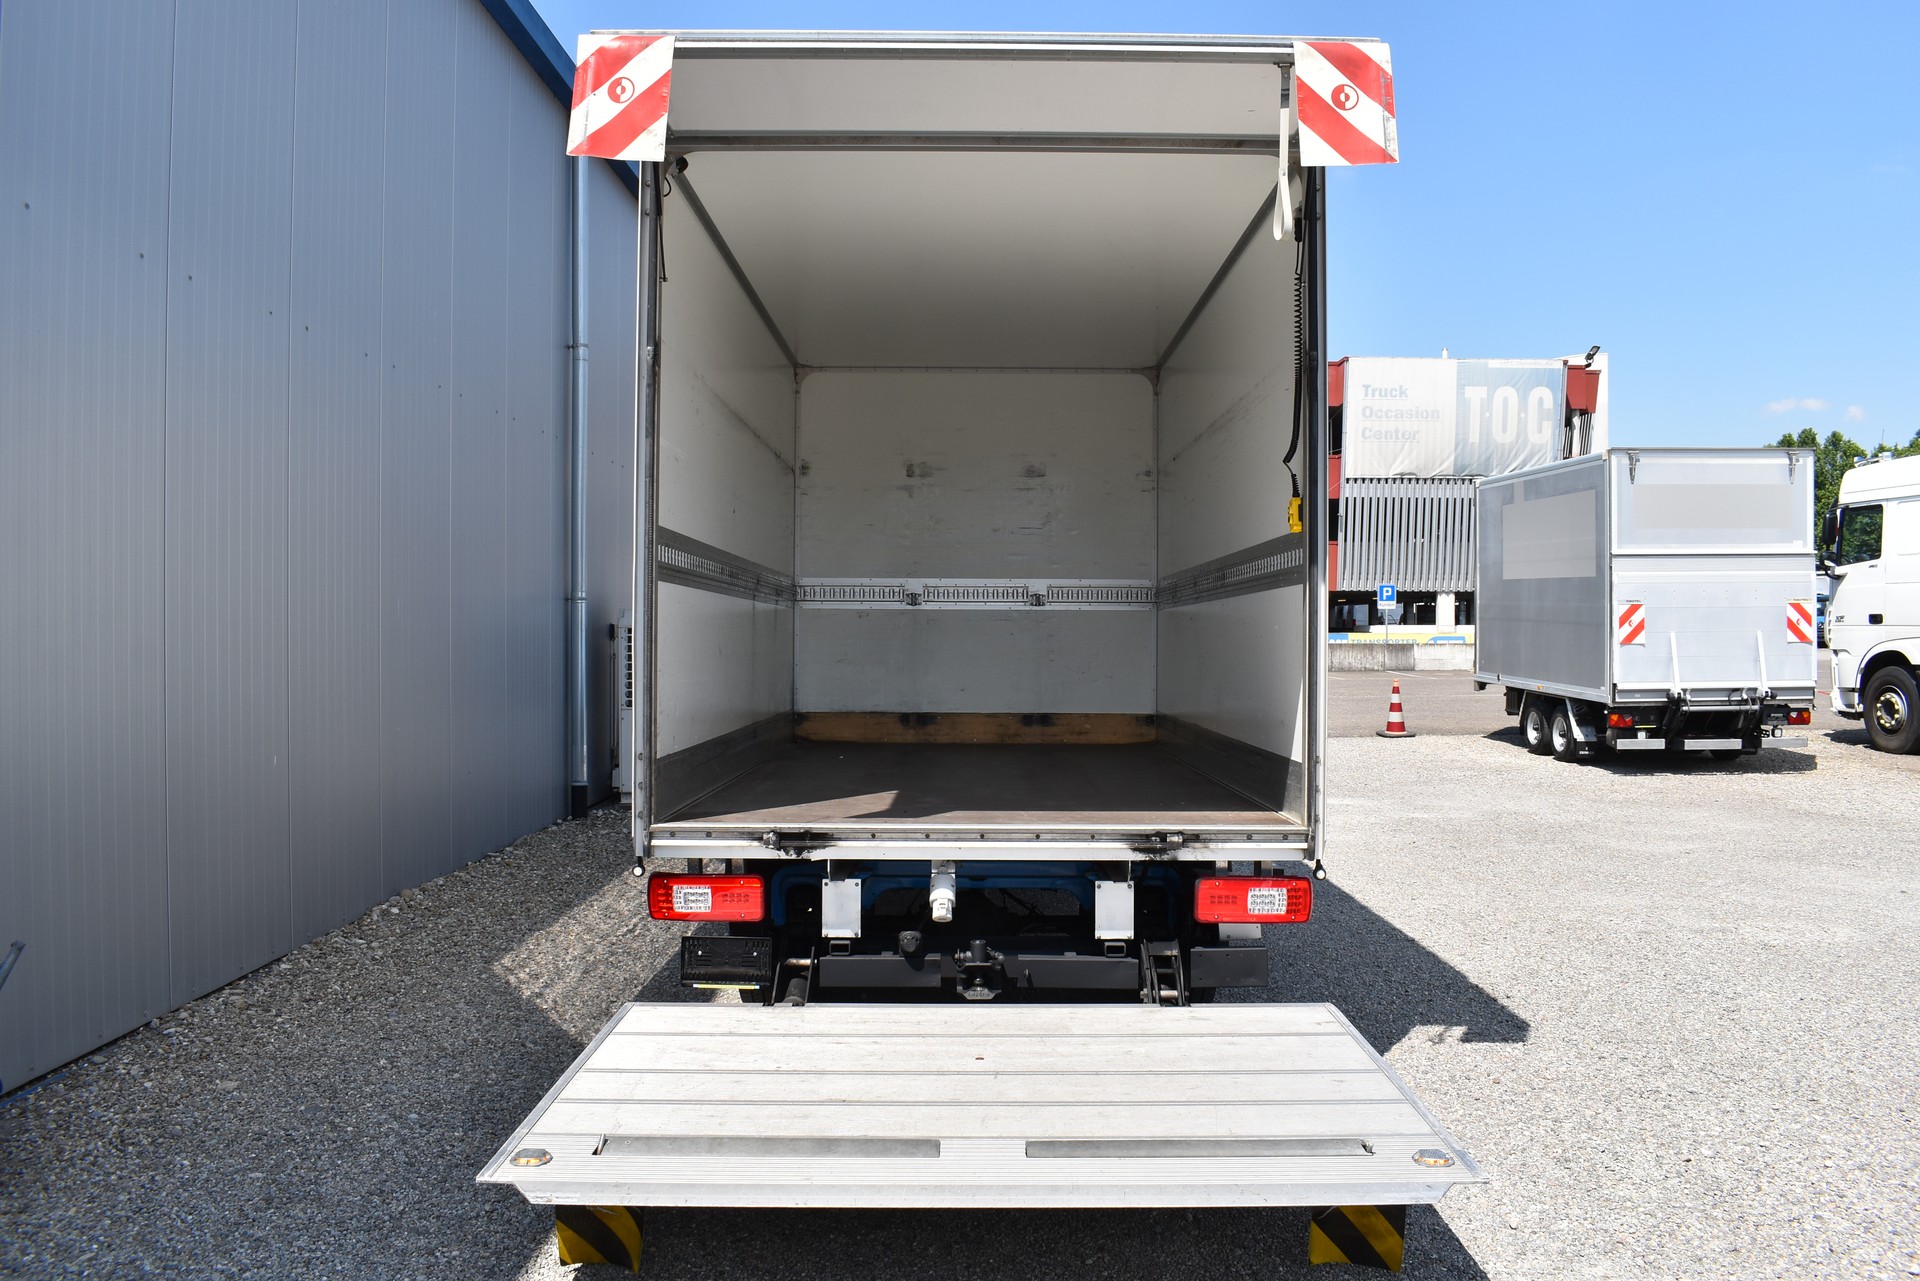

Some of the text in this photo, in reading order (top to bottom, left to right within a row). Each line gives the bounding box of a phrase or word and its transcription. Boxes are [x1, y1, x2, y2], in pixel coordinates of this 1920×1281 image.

[1361, 383, 1409, 399] Truck
[1361, 405, 1441, 420] Occasion
[1360, 426, 1420, 441] Center
[1382, 587, 1392, 600] P
